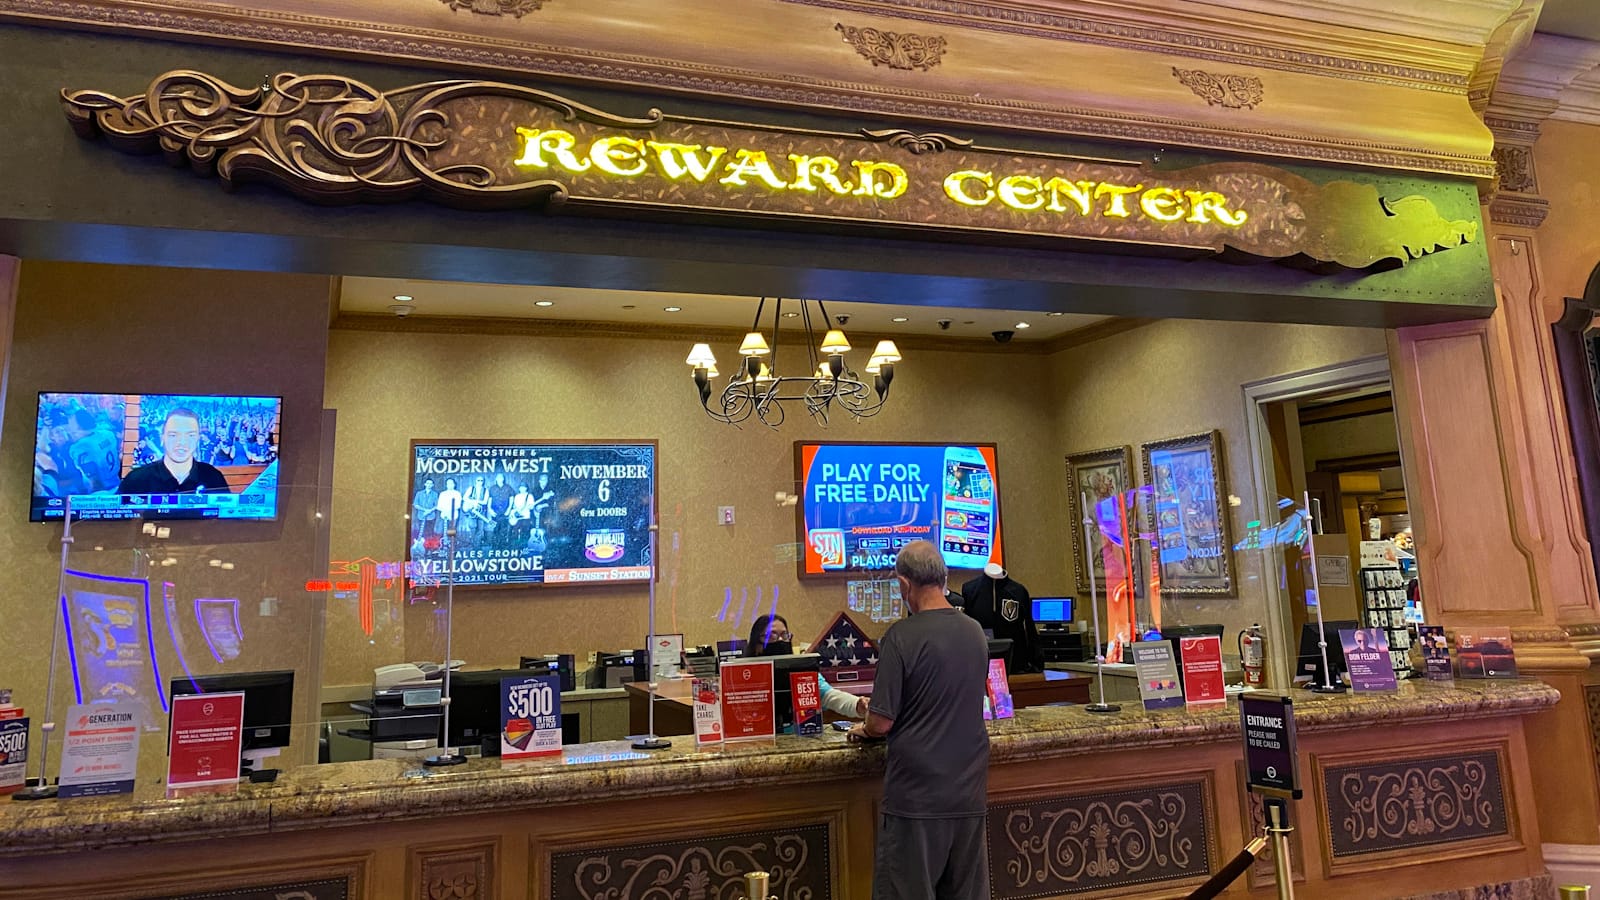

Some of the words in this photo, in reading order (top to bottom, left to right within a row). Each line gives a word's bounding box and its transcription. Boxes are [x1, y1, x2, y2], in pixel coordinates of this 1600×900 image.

[514, 126, 909, 199] REWARD
[943, 170, 1247, 226] CENTER
[434, 449, 469, 457] KEVIN
[475, 449, 525, 457] COSTNER
[416, 457, 496, 474] MODERN
[501, 457, 552, 473] WEST
[560, 465, 648, 480] NOVEMBER
[822, 464, 873, 482] PLAY
[879, 464, 921, 482] FOR
[597, 479, 610, 502] 6
[815, 485, 868, 503] FREE
[873, 484, 930, 502] DAILY
[597, 508, 627, 517] DOORS
[455, 550, 484, 558] ALES
[489, 549, 518, 558] FROM
[420, 556, 543, 574] YELLOWSTONE
[852, 555, 897, 567] PLAY.SC
[569, 571, 609, 581] SUNSET
[610, 569, 650, 580] STATION
[1360, 652, 1381, 660] FELDER
[797, 682, 816, 694] BEST
[508, 687, 553, 719] $500
[798, 697, 817, 707] VEGAS
[89, 712, 133, 724] GENERATION
[697, 711, 714, 719] CHARGE
[1247, 714, 1283, 728] ENTRANCE
[108, 735, 134, 743] DINING
[1248, 730, 1265, 739] PLEASE
[0, 732, 27, 754] $500
[1249, 738, 1255, 746] TO
[1256, 739, 1262, 747] BE
[1262, 740, 1281, 749] CALLED
